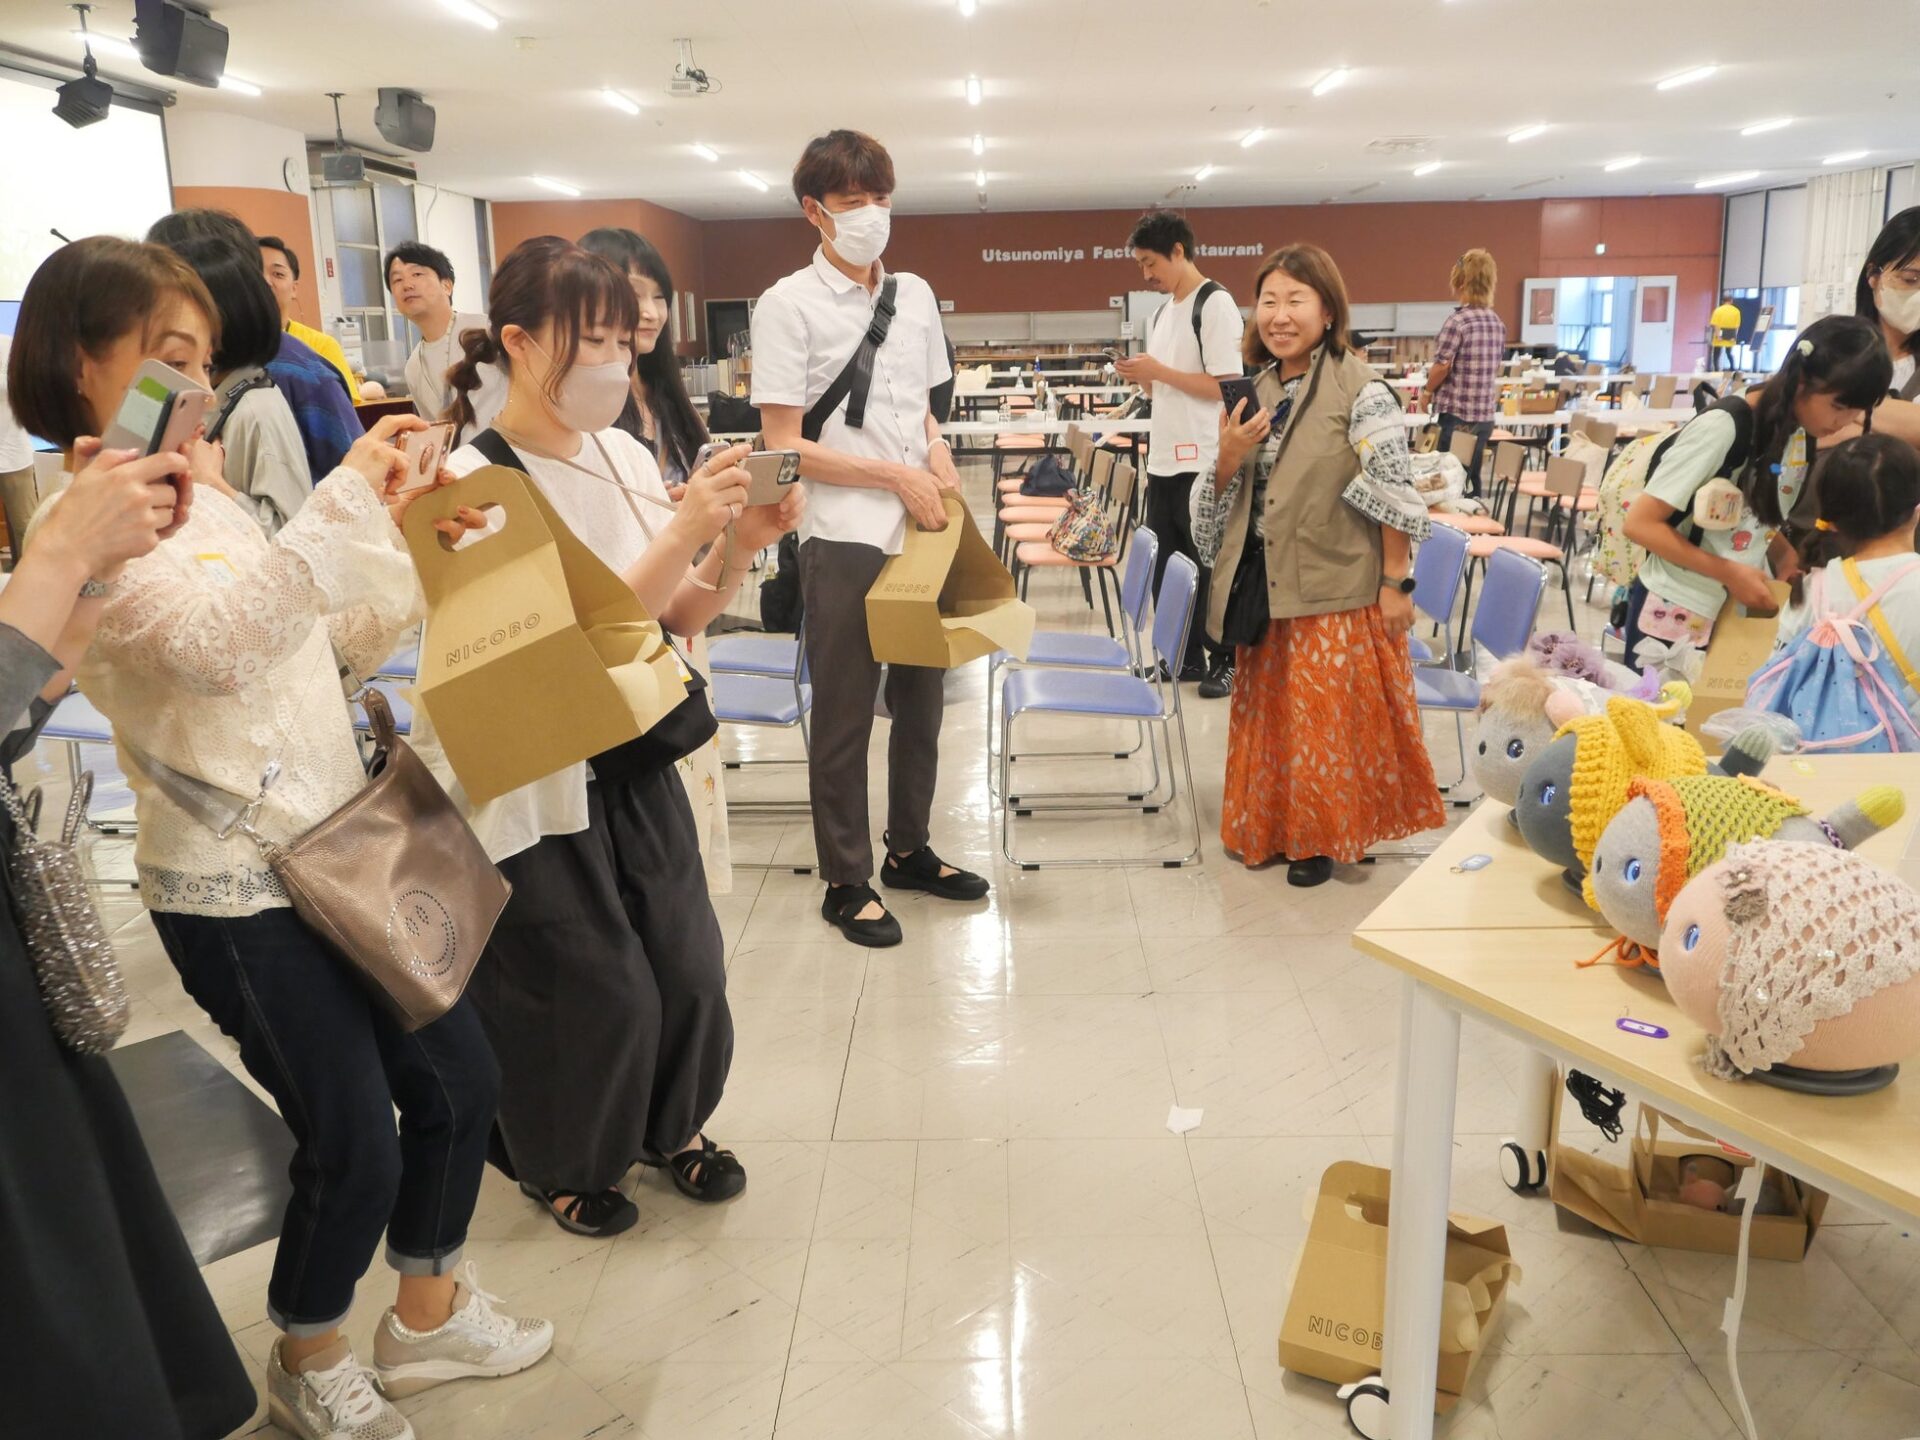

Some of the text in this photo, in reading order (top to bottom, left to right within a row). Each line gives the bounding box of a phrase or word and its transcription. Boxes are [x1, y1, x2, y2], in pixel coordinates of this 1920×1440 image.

[982, 247, 1085, 263] Utsunomiya
[1093, 245, 1137, 260] Facto
[446, 612, 541, 667] NICOBO
[1706, 676, 1746, 690] NICO
[1308, 1315, 1383, 1351] NICOB
